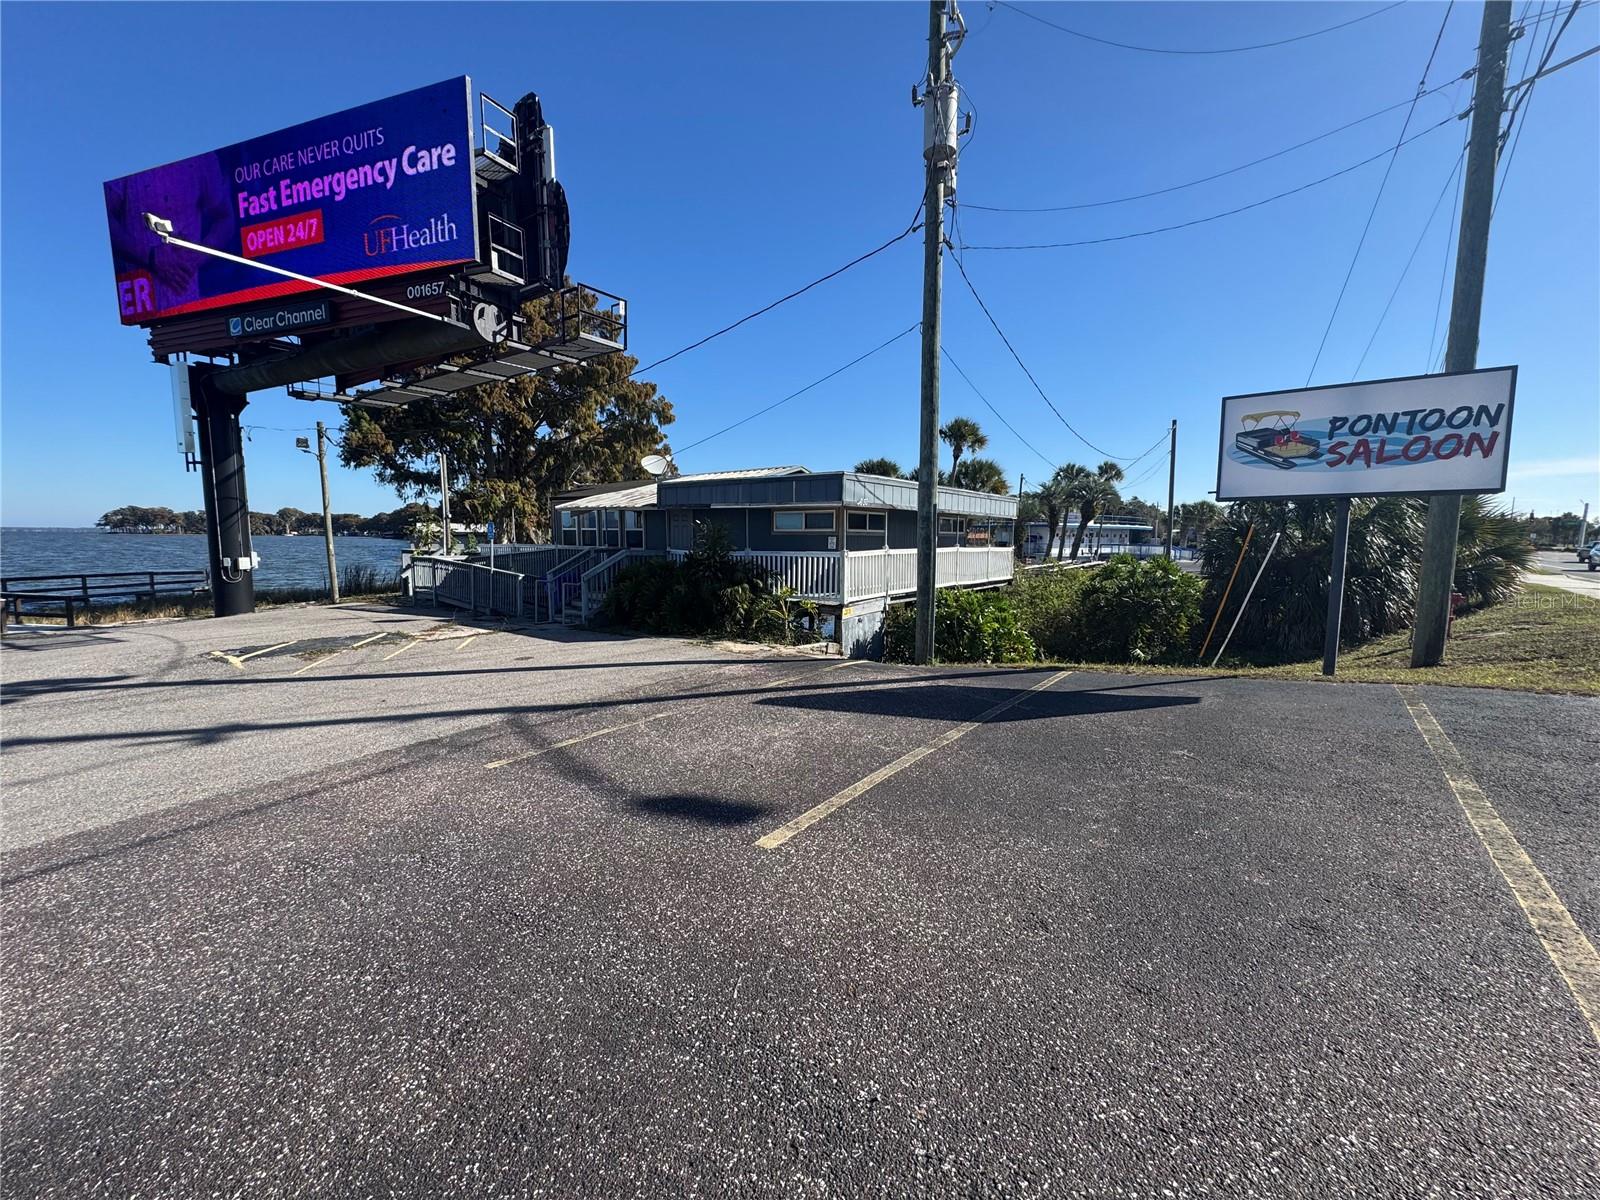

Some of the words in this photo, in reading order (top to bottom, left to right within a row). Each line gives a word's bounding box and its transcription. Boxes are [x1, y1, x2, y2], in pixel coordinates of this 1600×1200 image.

[234, 164, 262, 184] OUR
[263, 152, 295, 178] CARE
[298, 139, 340, 167] NEVER
[342, 127, 385, 155] QUITS
[238, 187, 278, 218] Fast
[279, 157, 398, 201] Emergency
[401, 143, 456, 176] Care
[246, 225, 285, 251] OPEN
[286, 217, 318, 243] 24/7
[118, 277, 153, 316] ER
[406, 281, 445, 299] 001657
[243, 314, 275, 332] Clear
[275, 304, 326, 327] Channel
[1327, 403, 1506, 441] PONTOON
[1325, 431, 1500, 469] SALOON
